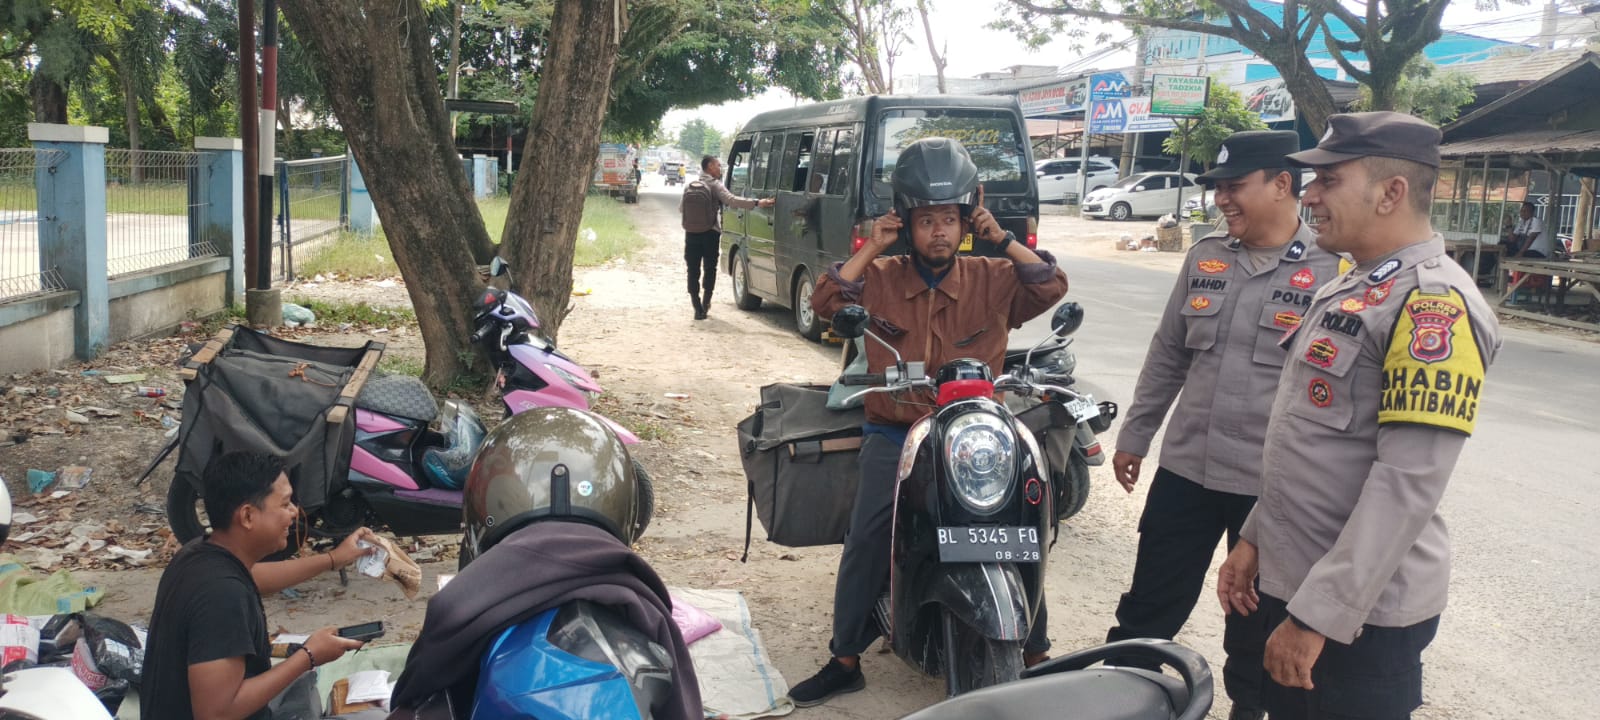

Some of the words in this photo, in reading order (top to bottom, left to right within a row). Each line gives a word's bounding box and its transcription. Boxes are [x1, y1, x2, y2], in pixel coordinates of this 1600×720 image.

[1092, 102, 1122, 119] AM
[1190, 278, 1227, 291] MAHDI
[1272, 290, 1313, 308] POLR
[1413, 301, 1458, 315] POLRES
[1321, 311, 1362, 337] POLRI
[938, 528, 957, 544] BL
[968, 528, 1008, 544] 5345
